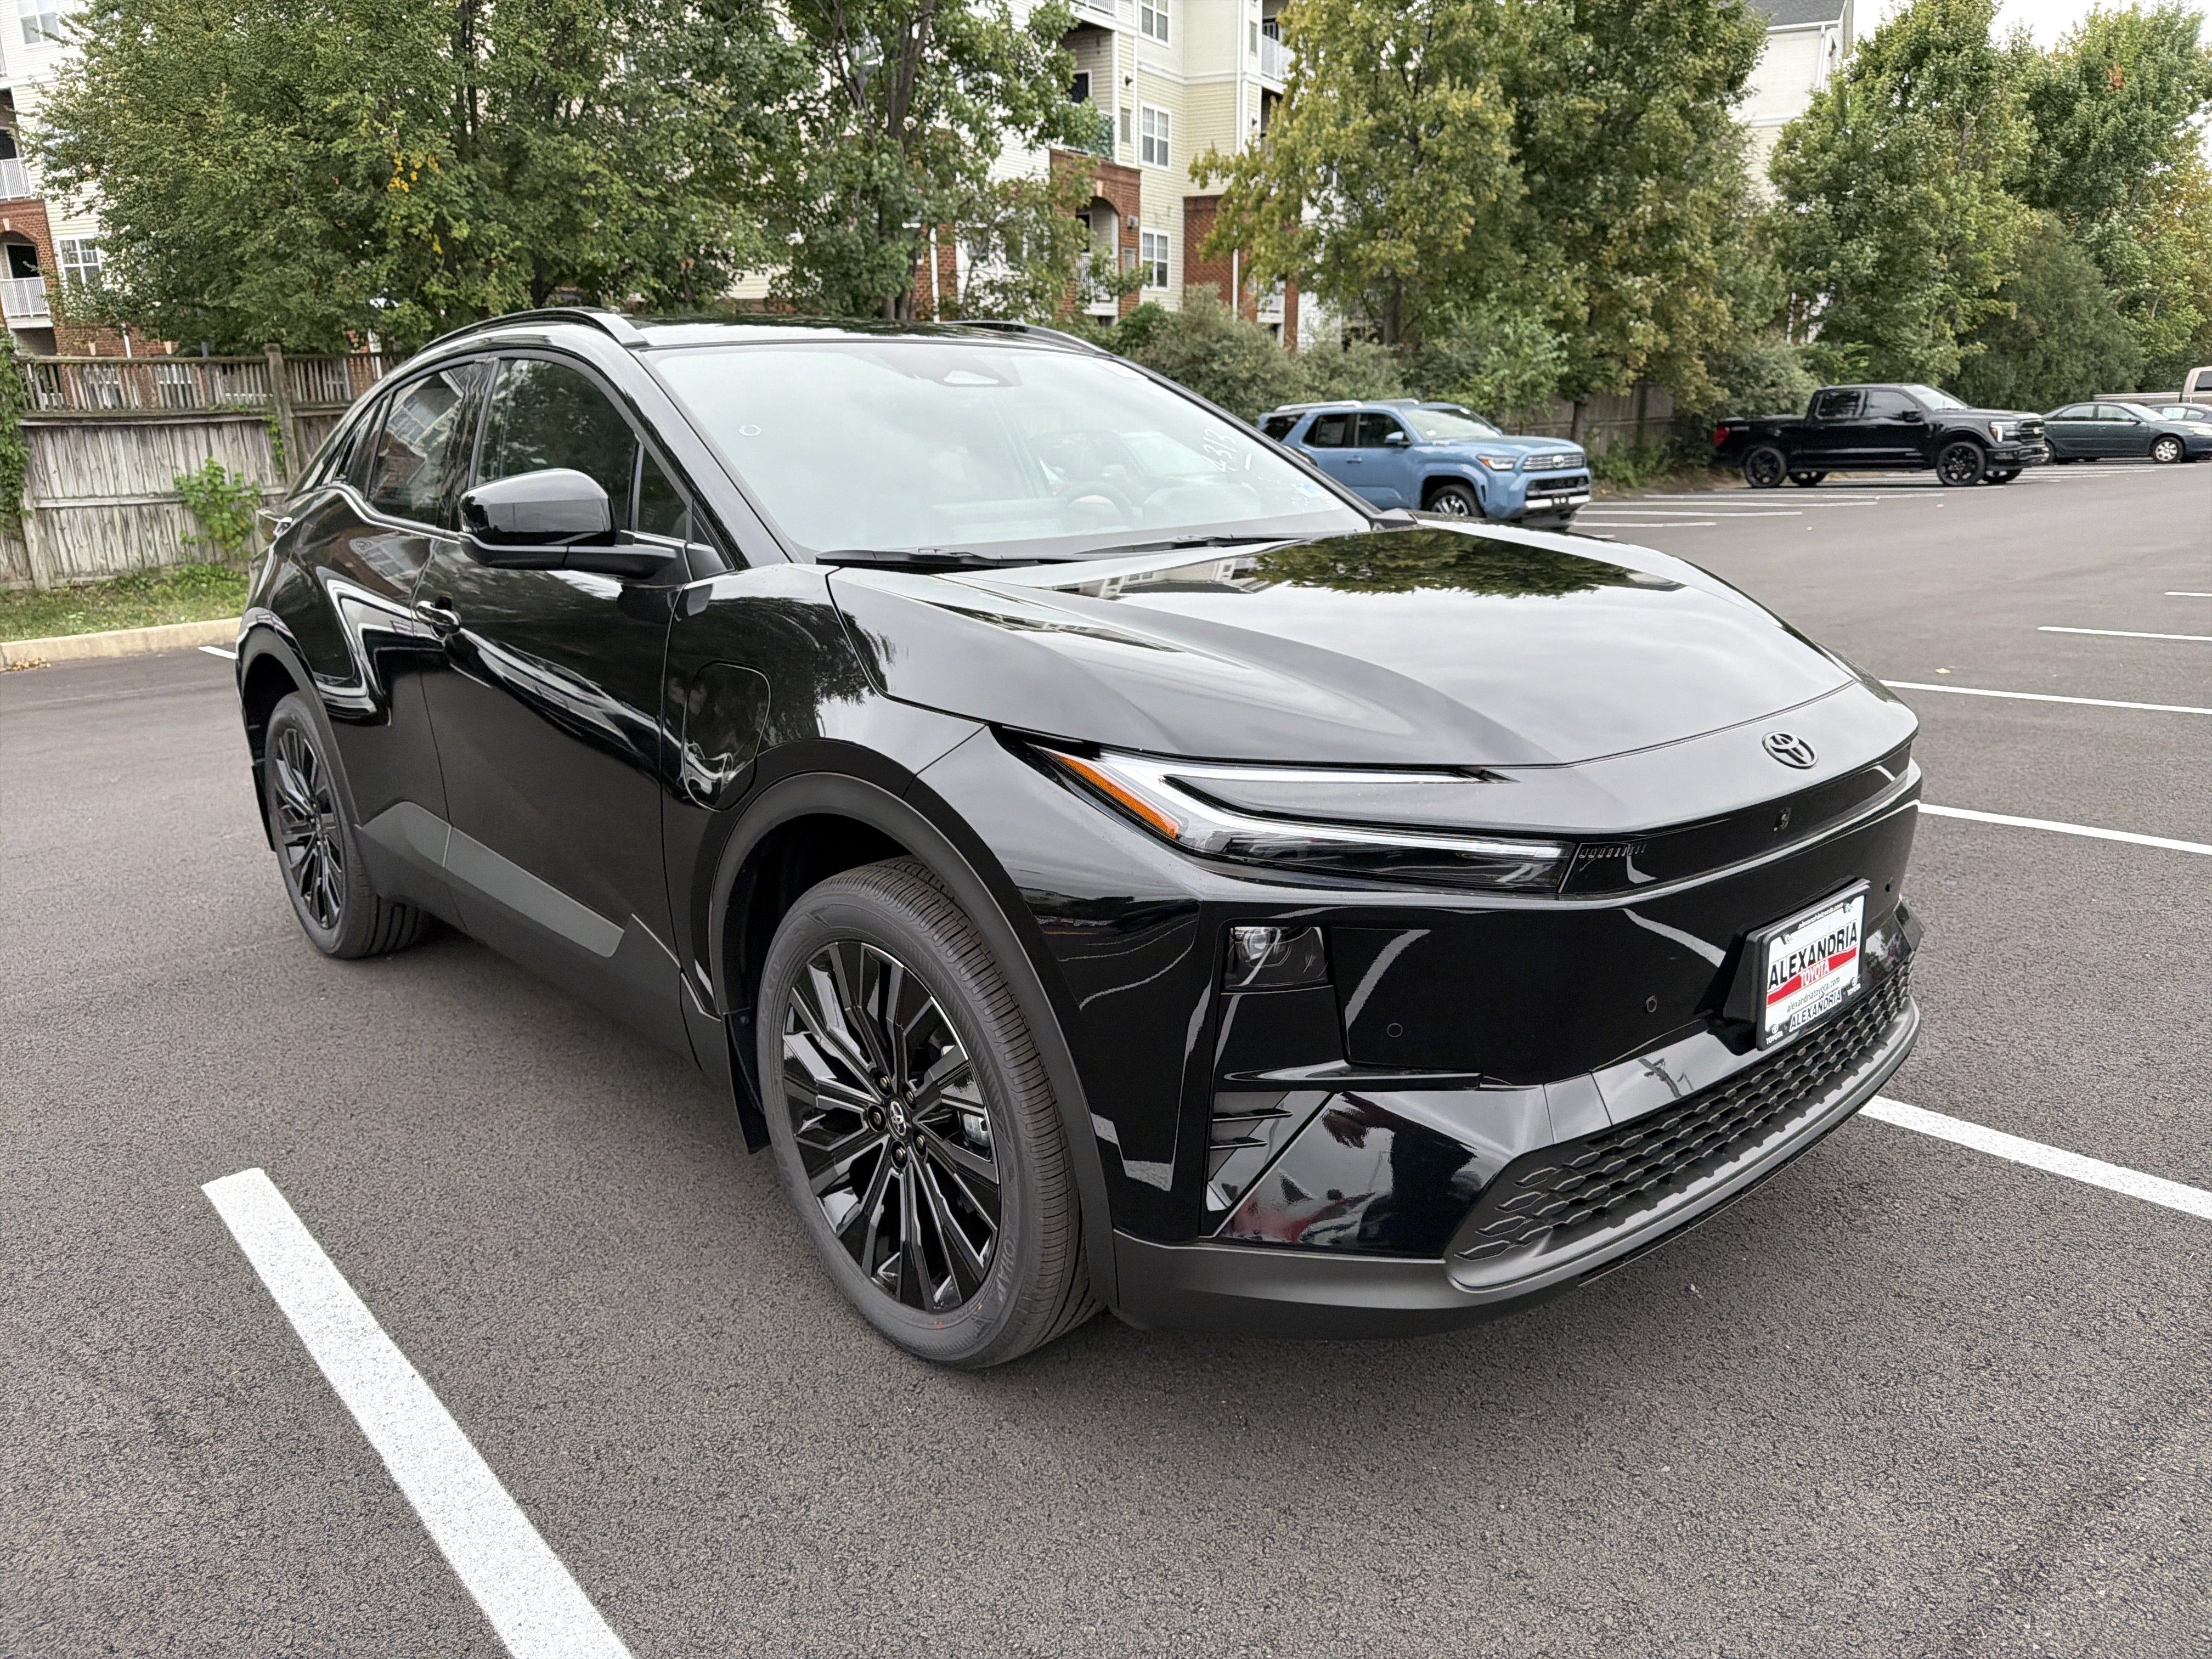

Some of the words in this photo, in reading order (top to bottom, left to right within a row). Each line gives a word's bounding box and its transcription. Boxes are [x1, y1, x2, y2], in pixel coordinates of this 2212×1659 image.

[1768, 922, 1857, 990] ALEXANDRIA
[1801, 958, 1830, 988] TOYOTA
[1787, 977, 1840, 1013] alexandriatoyota.com
[1790, 989, 1841, 1030] ALEXANDRIA
[1766, 1031, 1784, 1045] TOYOTA
